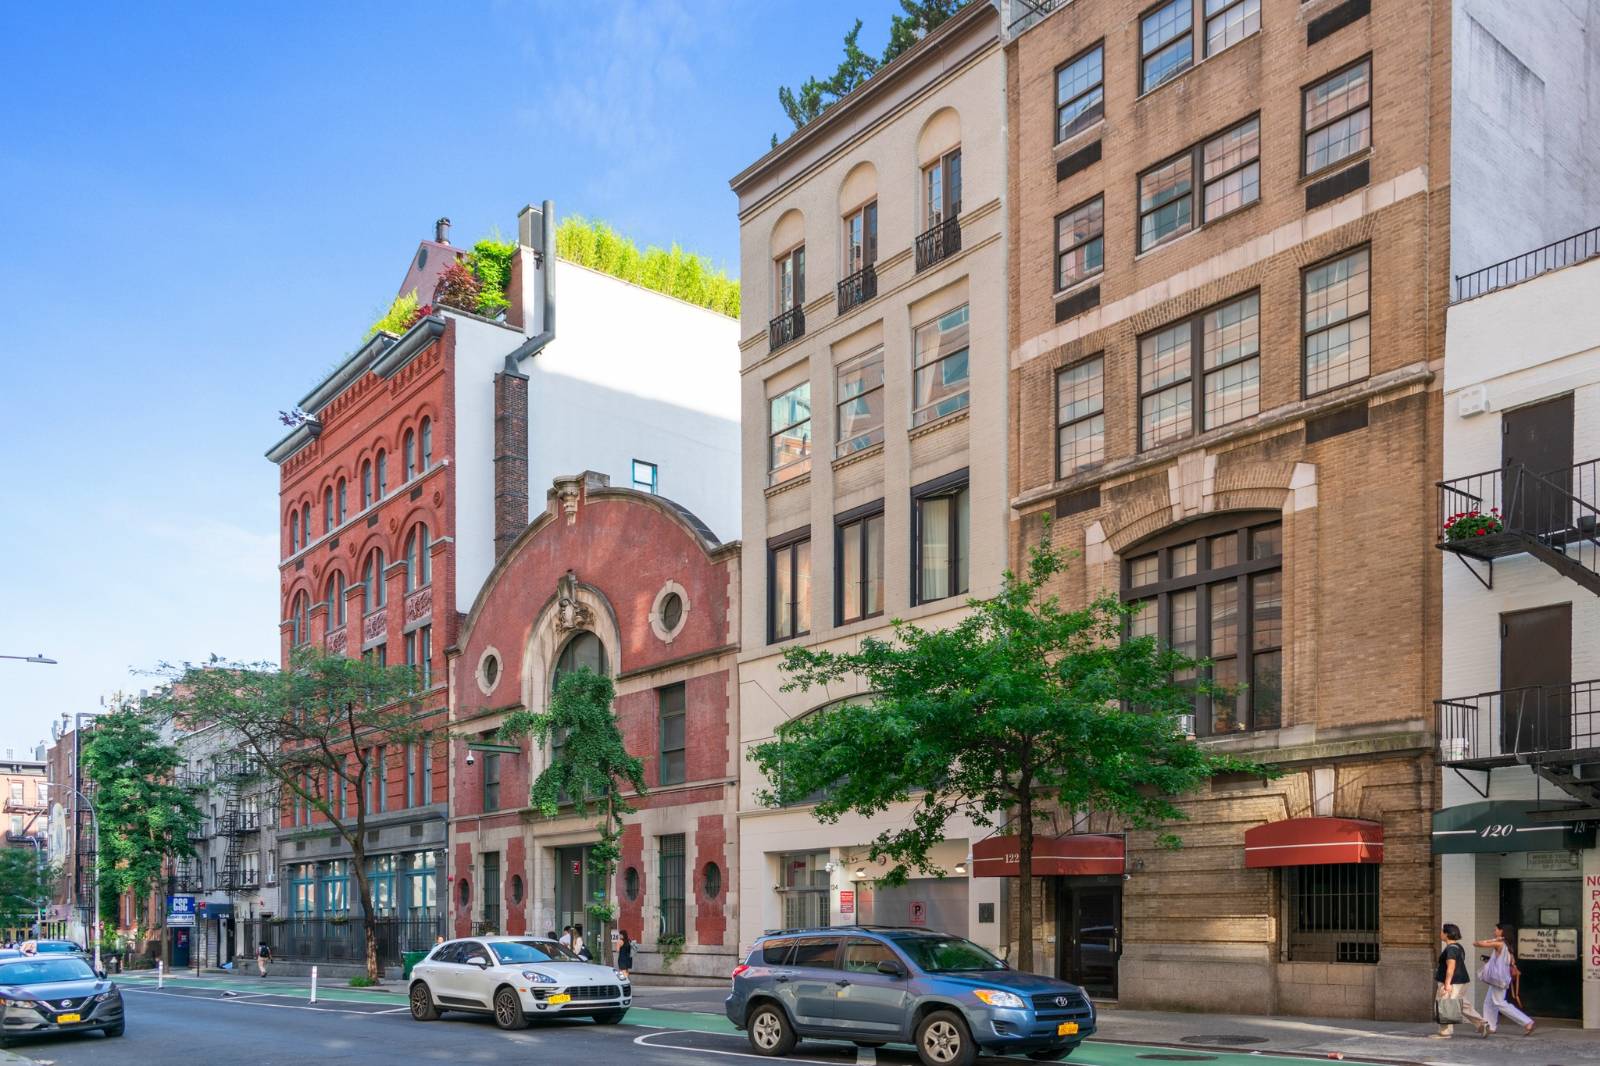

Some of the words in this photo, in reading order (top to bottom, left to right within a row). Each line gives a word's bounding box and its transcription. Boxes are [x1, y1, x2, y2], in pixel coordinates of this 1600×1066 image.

[1480, 824, 1513, 837] 120
[1004, 853, 1019, 864] 122
[173, 898, 188, 911] CSC
